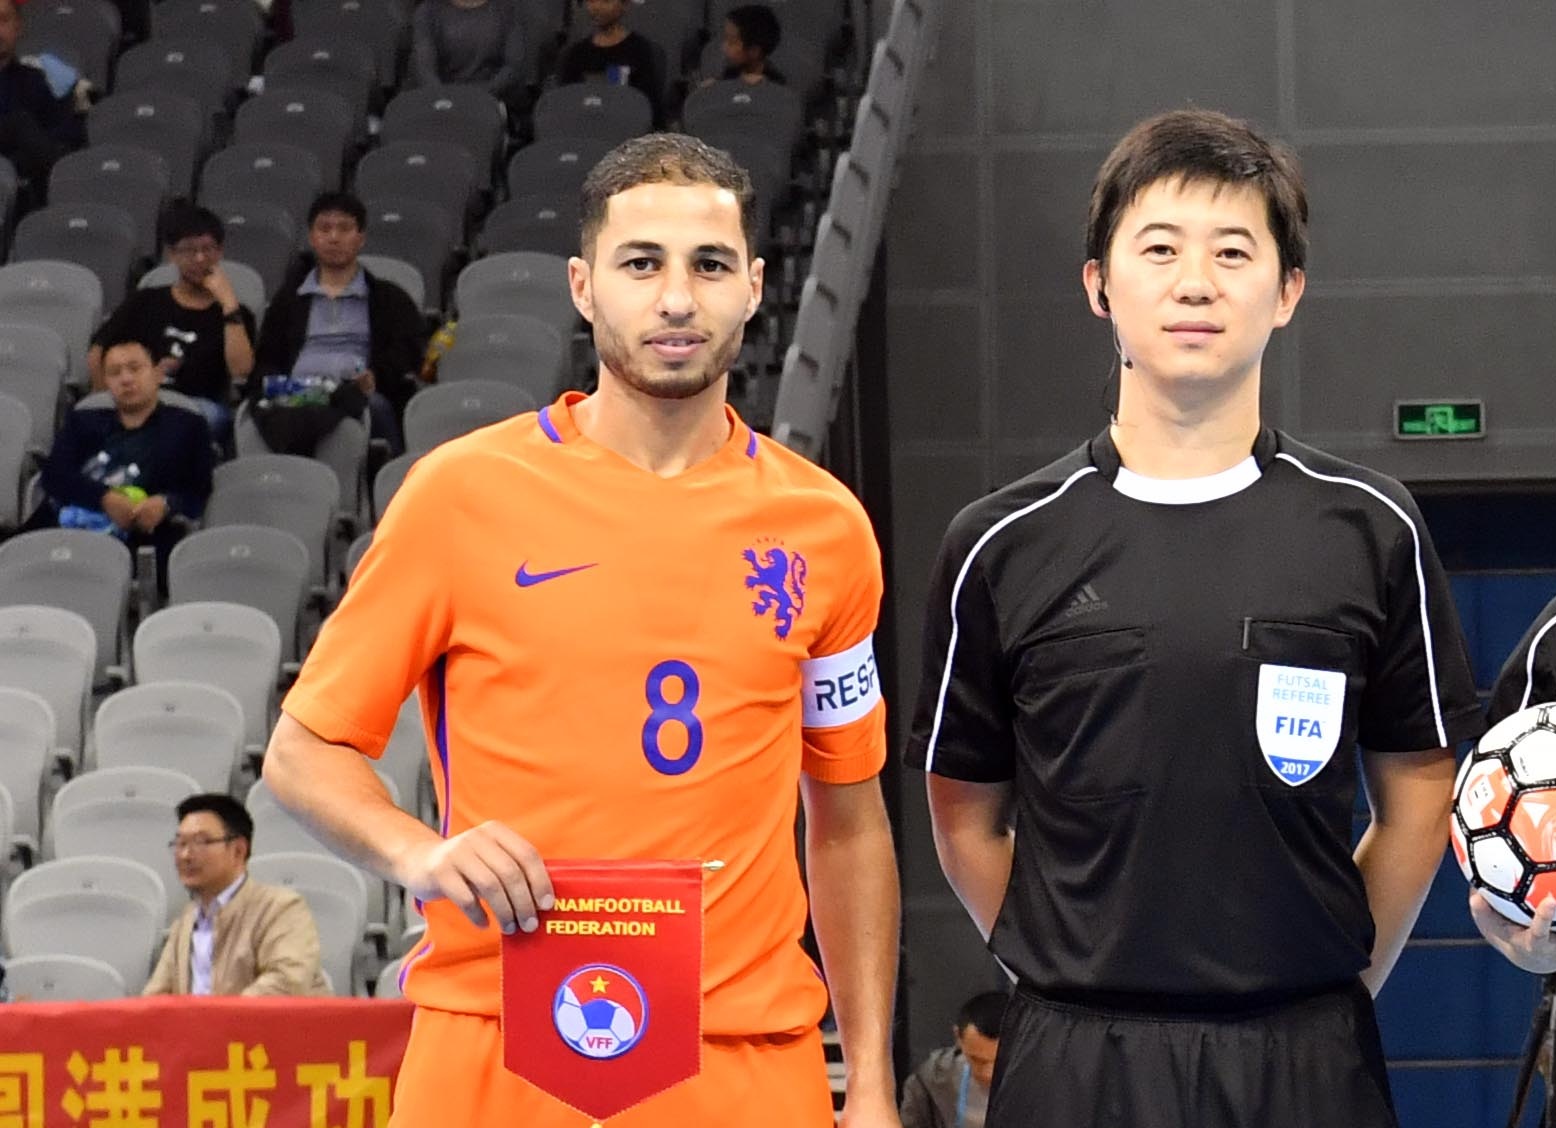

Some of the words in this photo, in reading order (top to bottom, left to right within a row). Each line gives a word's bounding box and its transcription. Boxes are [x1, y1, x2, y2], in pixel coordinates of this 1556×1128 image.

[1277, 674, 1328, 690] FUTSAL
[1272, 688, 1331, 705] REFEREE
[643, 660, 702, 775] 8
[1275, 716, 1322, 739] FIFA
[1280, 761, 1311, 776] 2017
[546, 920, 655, 936] FEDERATION
[586, 1036, 613, 1049] VFF
